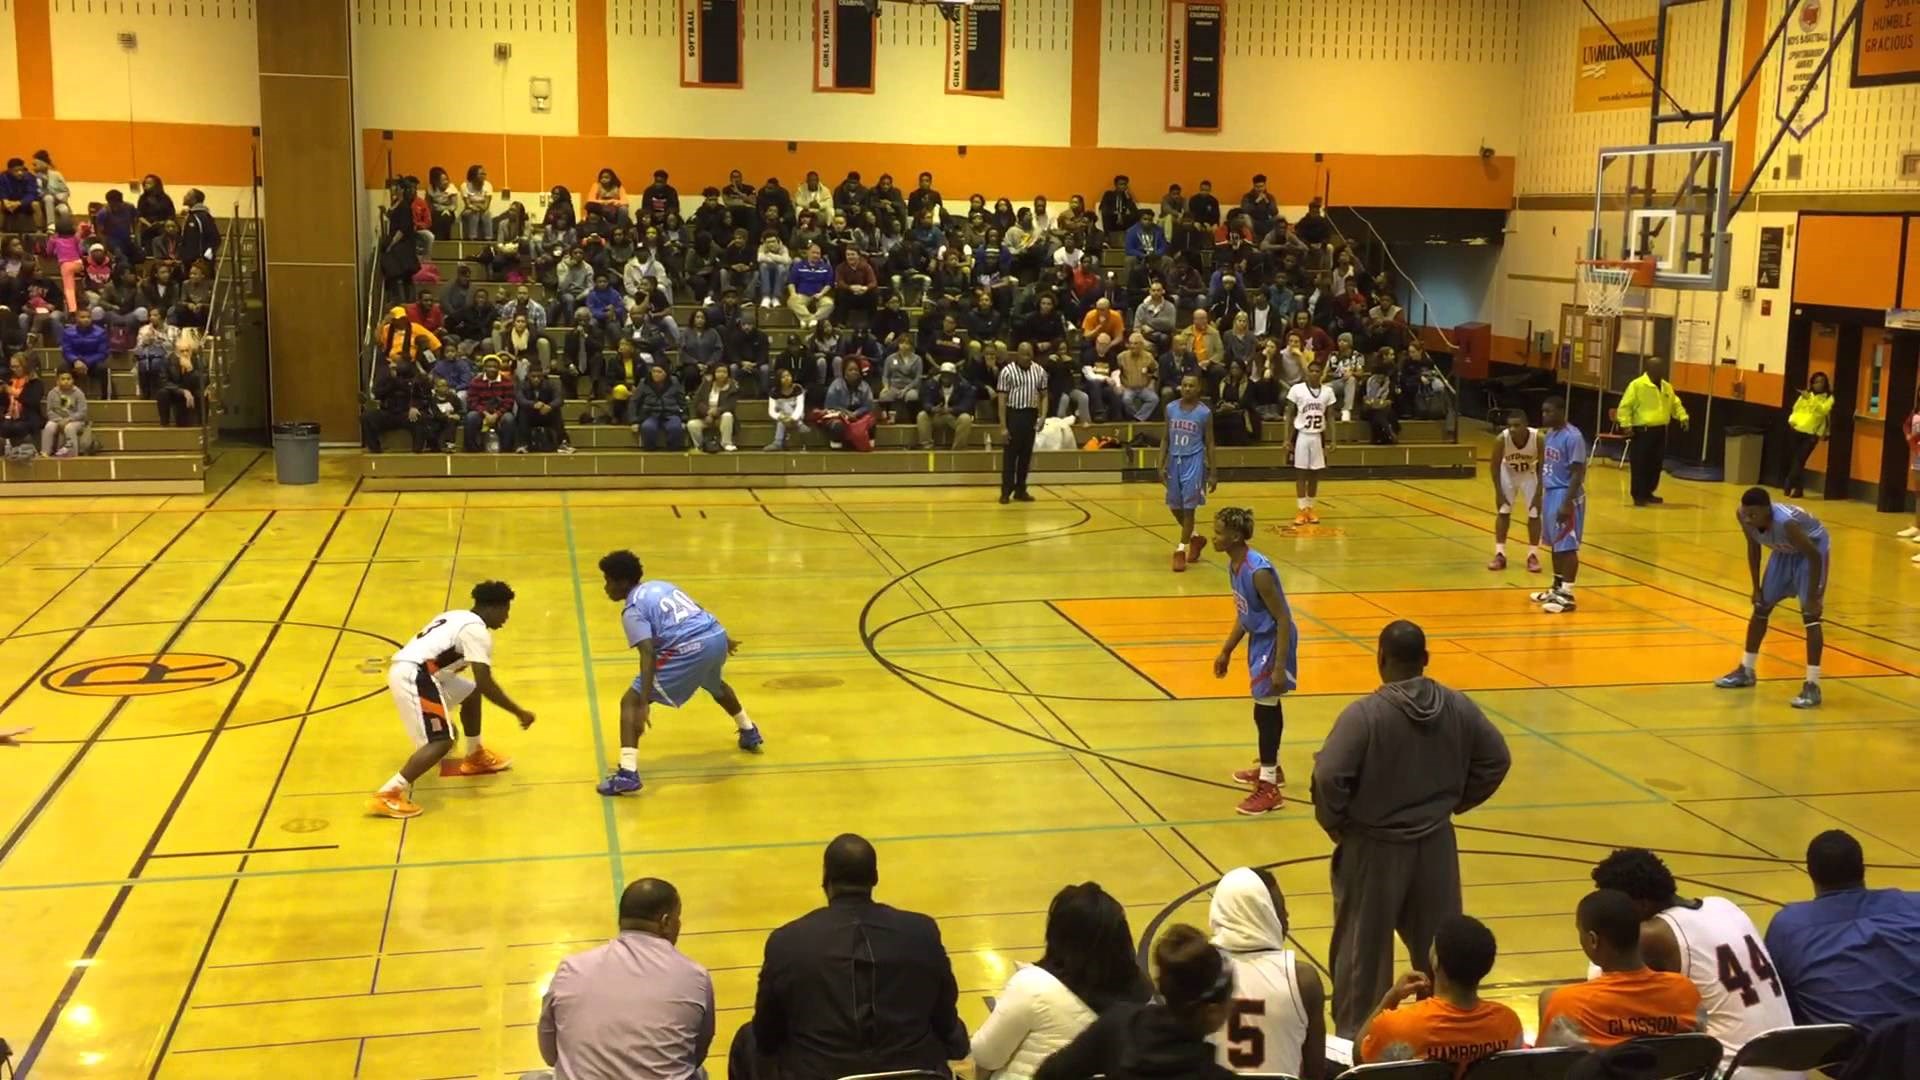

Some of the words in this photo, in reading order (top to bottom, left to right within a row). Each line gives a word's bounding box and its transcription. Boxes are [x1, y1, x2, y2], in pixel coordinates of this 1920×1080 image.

[688, 10, 696, 57] SOFTBALL
[1872, 12, 1913, 32] HUMBLE
[1173, 39, 1181, 65] TRACK
[1864, 35, 1914, 53] GRACIOUS
[953, 60, 961, 88] GIRLS
[1304, 415, 1323, 429] 32
[1174, 434, 1189, 446] 10
[660, 589, 702, 624] 20
[1717, 934, 1781, 1008] 44
[1227, 998, 1265, 1069] 5
[1608, 1016, 1678, 1034] GLOSSON
